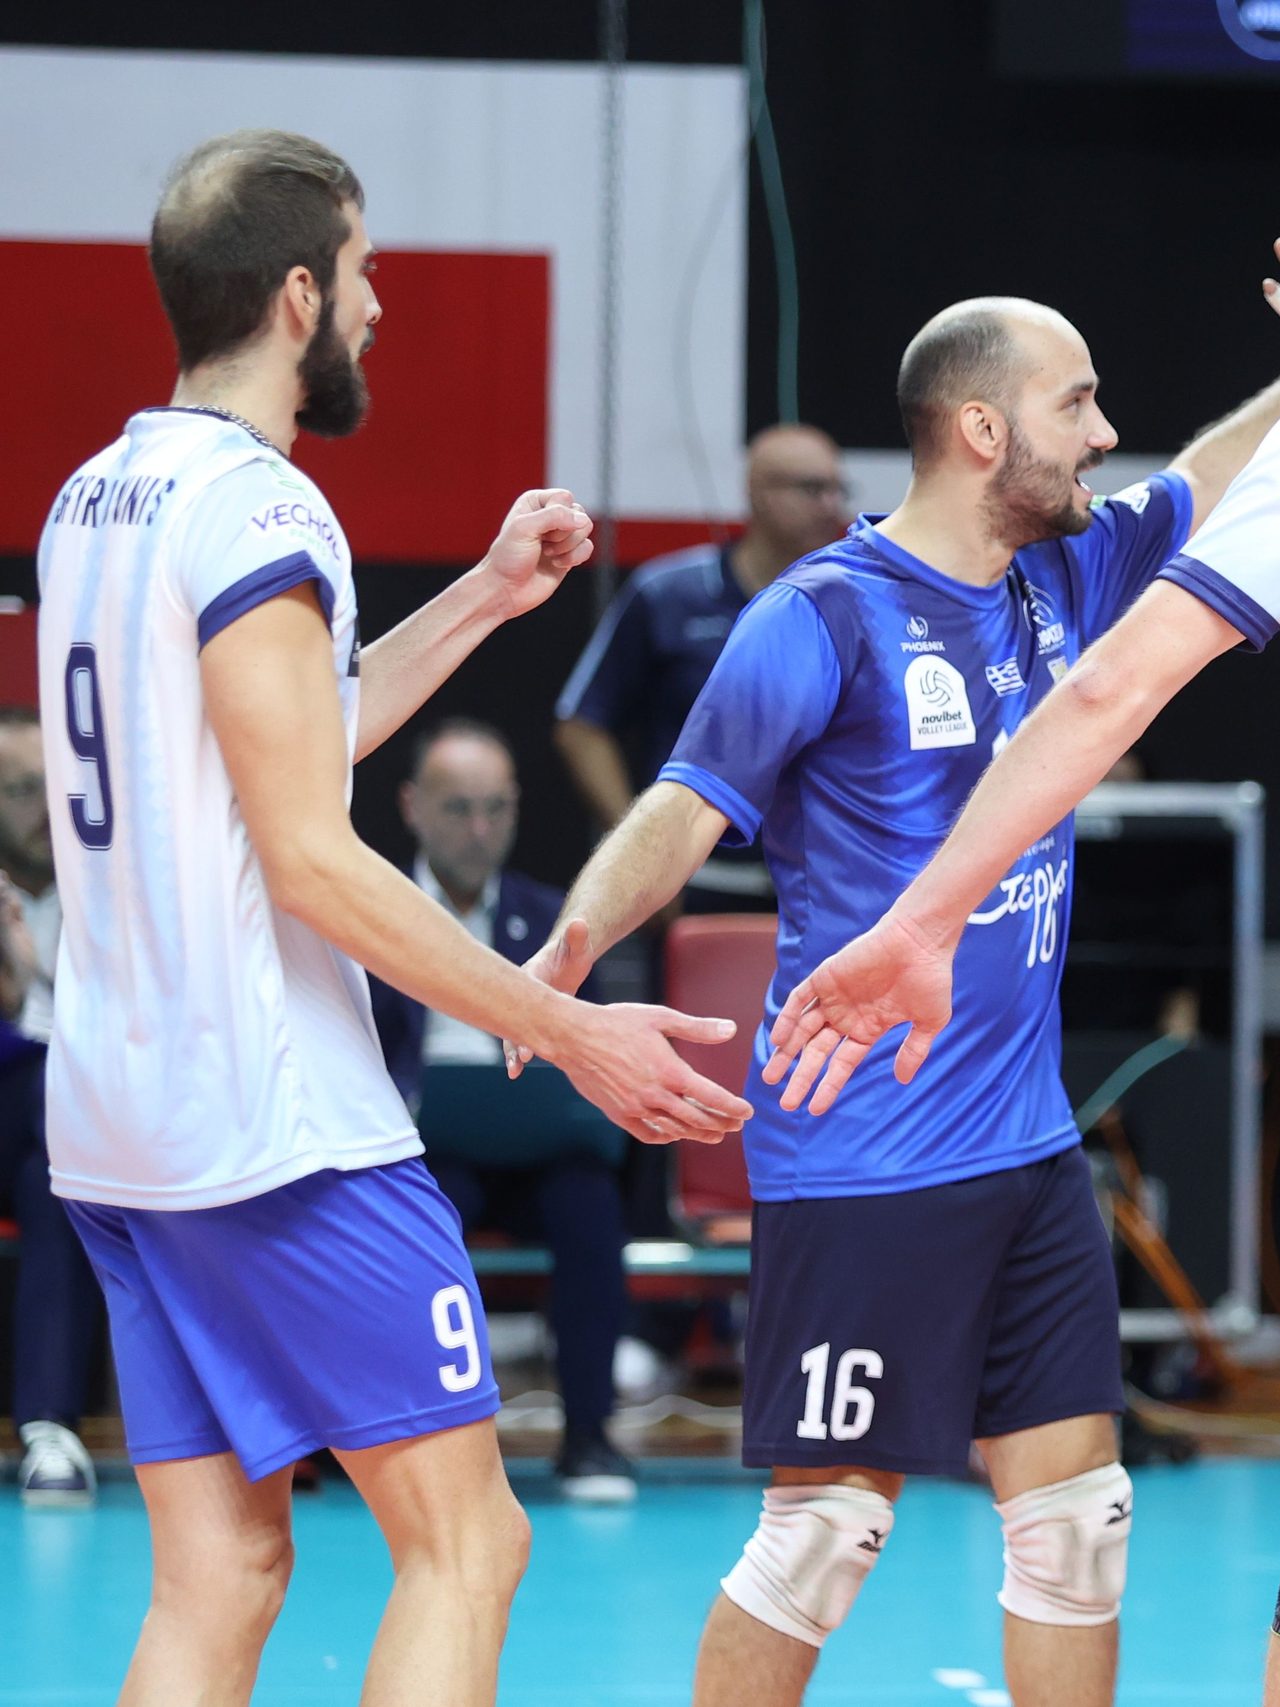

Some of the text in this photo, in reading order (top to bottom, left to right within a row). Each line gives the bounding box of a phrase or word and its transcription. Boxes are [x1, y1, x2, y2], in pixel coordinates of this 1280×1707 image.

[900, 641, 946, 652] PHOENIX
[917, 725, 943, 735] VOLLEY
[921, 710, 962, 724] novibet
[65, 642, 114, 850] 9
[431, 1284, 482, 1393] 9
[796, 1341, 884, 1441] 16
